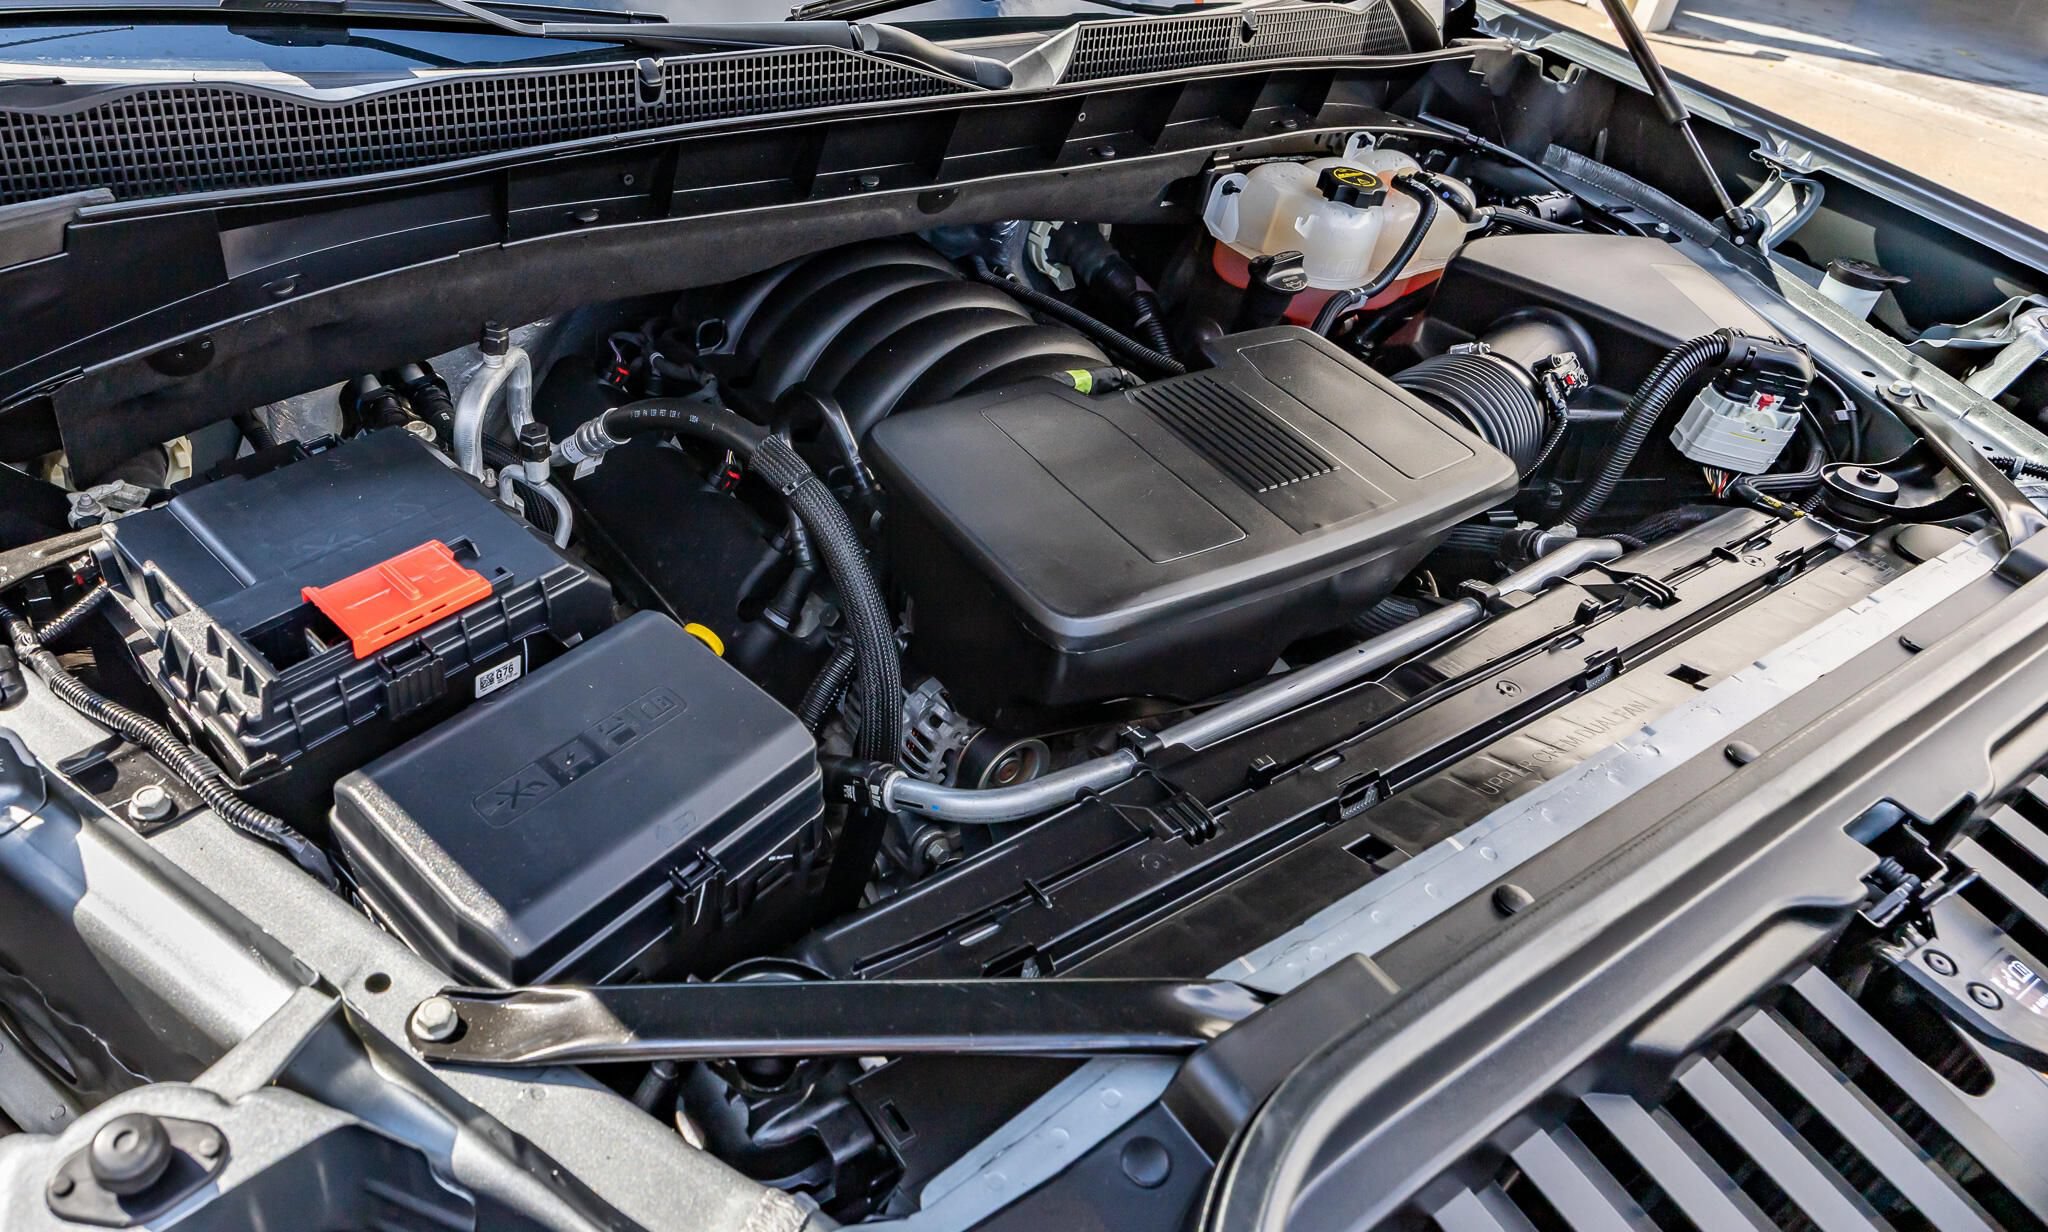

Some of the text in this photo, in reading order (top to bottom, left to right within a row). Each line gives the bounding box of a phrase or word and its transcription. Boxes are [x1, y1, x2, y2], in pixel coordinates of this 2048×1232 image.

[495, 663, 514, 680] G76
[1482, 758, 1536, 795] UPPER
[1574, 715, 1616, 742] DUAL
[1612, 700, 1650, 720] FAN
